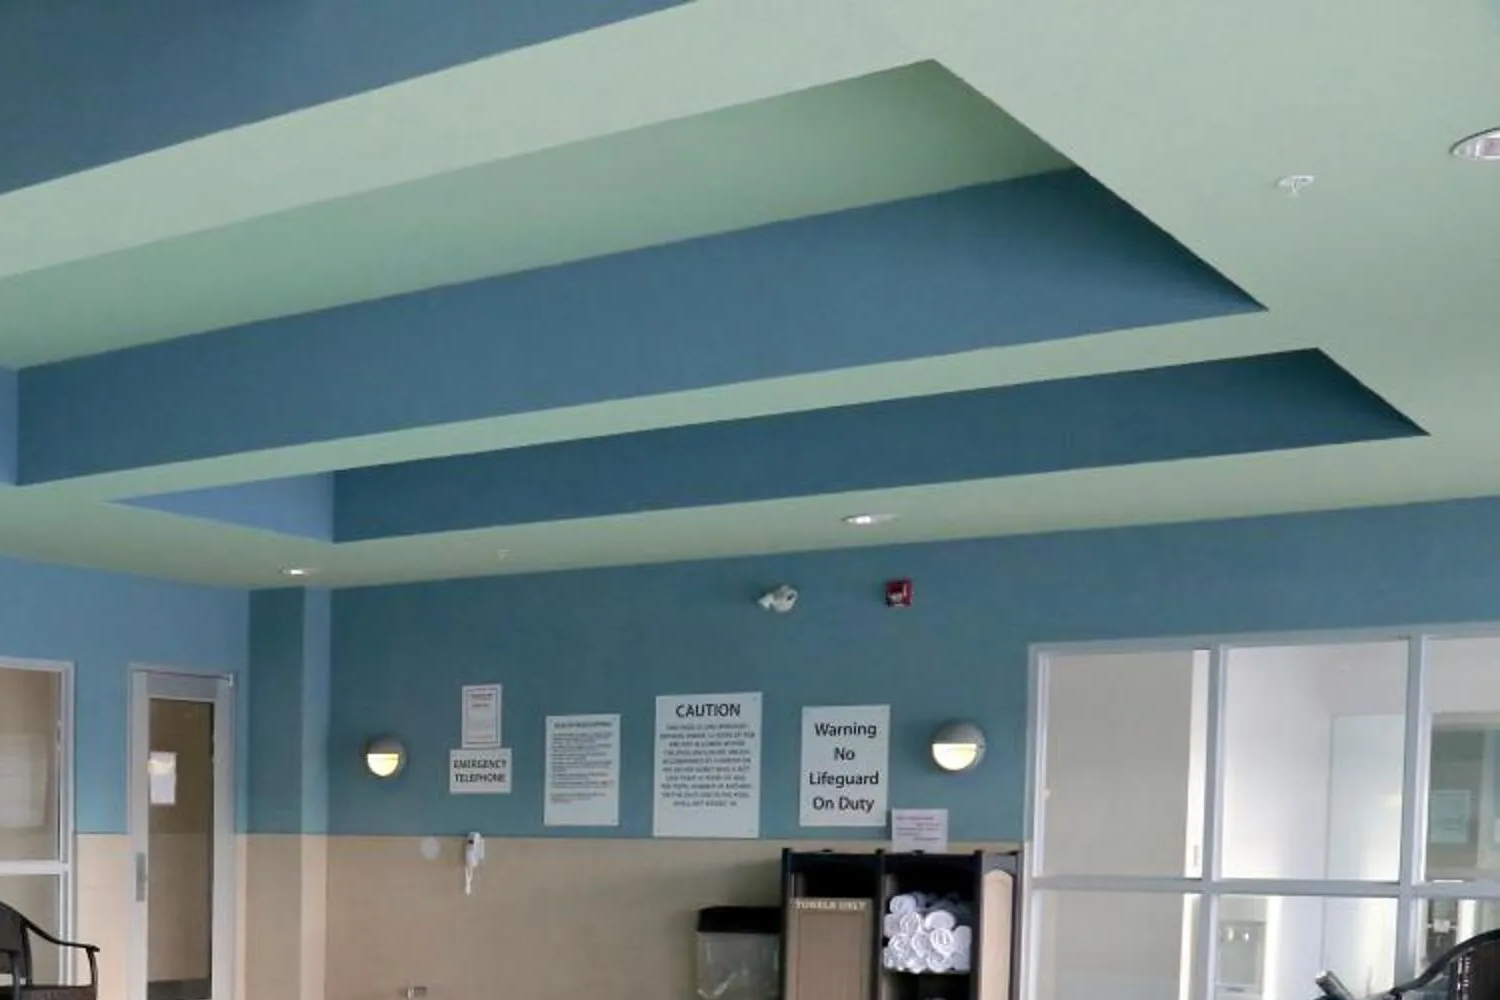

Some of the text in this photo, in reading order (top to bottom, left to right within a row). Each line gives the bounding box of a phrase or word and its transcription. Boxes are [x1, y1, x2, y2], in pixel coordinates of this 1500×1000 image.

[675, 703, 741, 718] CAUTION
[814, 721, 877, 738] Warning
[834, 747, 856, 760] No
[809, 771, 879, 788] Lifeguard
[812, 795, 875, 813] On Duty
